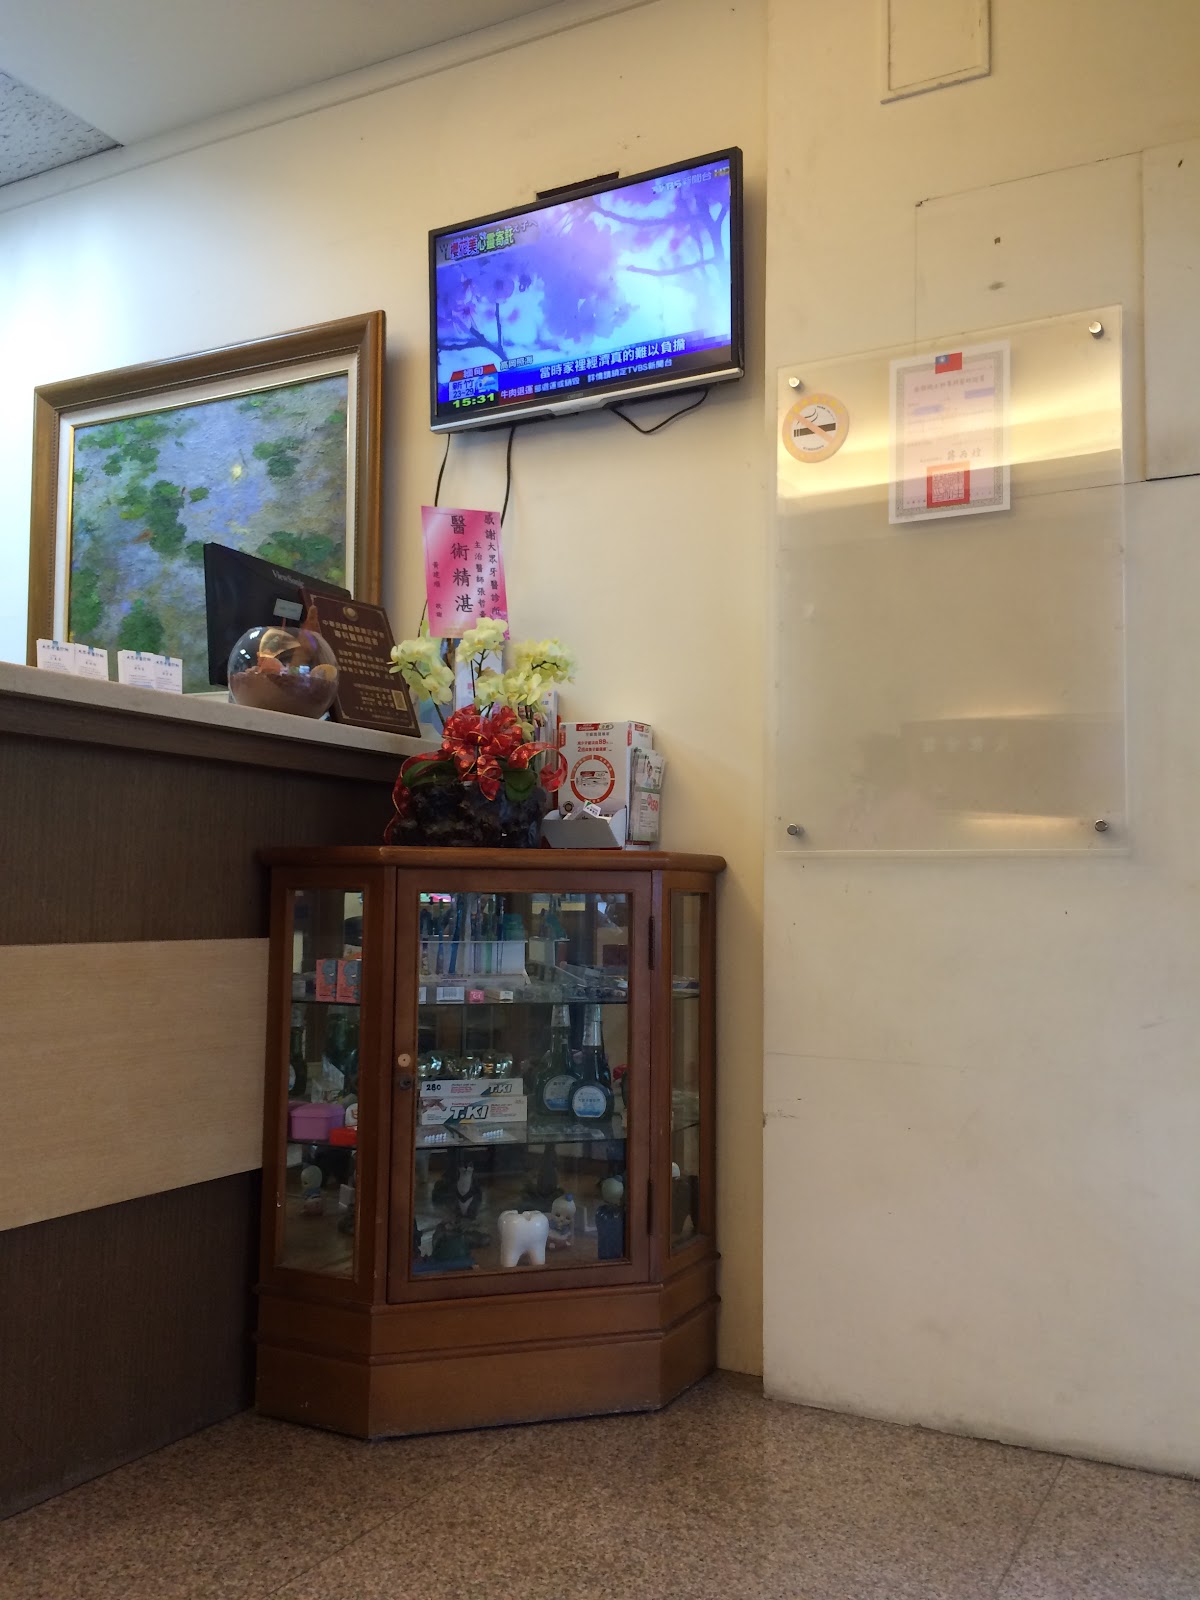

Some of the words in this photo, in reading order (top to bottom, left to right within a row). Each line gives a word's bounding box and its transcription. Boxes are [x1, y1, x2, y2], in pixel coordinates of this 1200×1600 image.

[539, 338, 686, 380] 當時家裡經濟真的難以負擔
[452, 379, 475, 390] 新竹
[452, 393, 496, 408] 15:31
[450, 515, 474, 613] 醫術精湛
[425, 1083, 442, 1092] 280
[449, 1104, 489, 1120] T.KI
